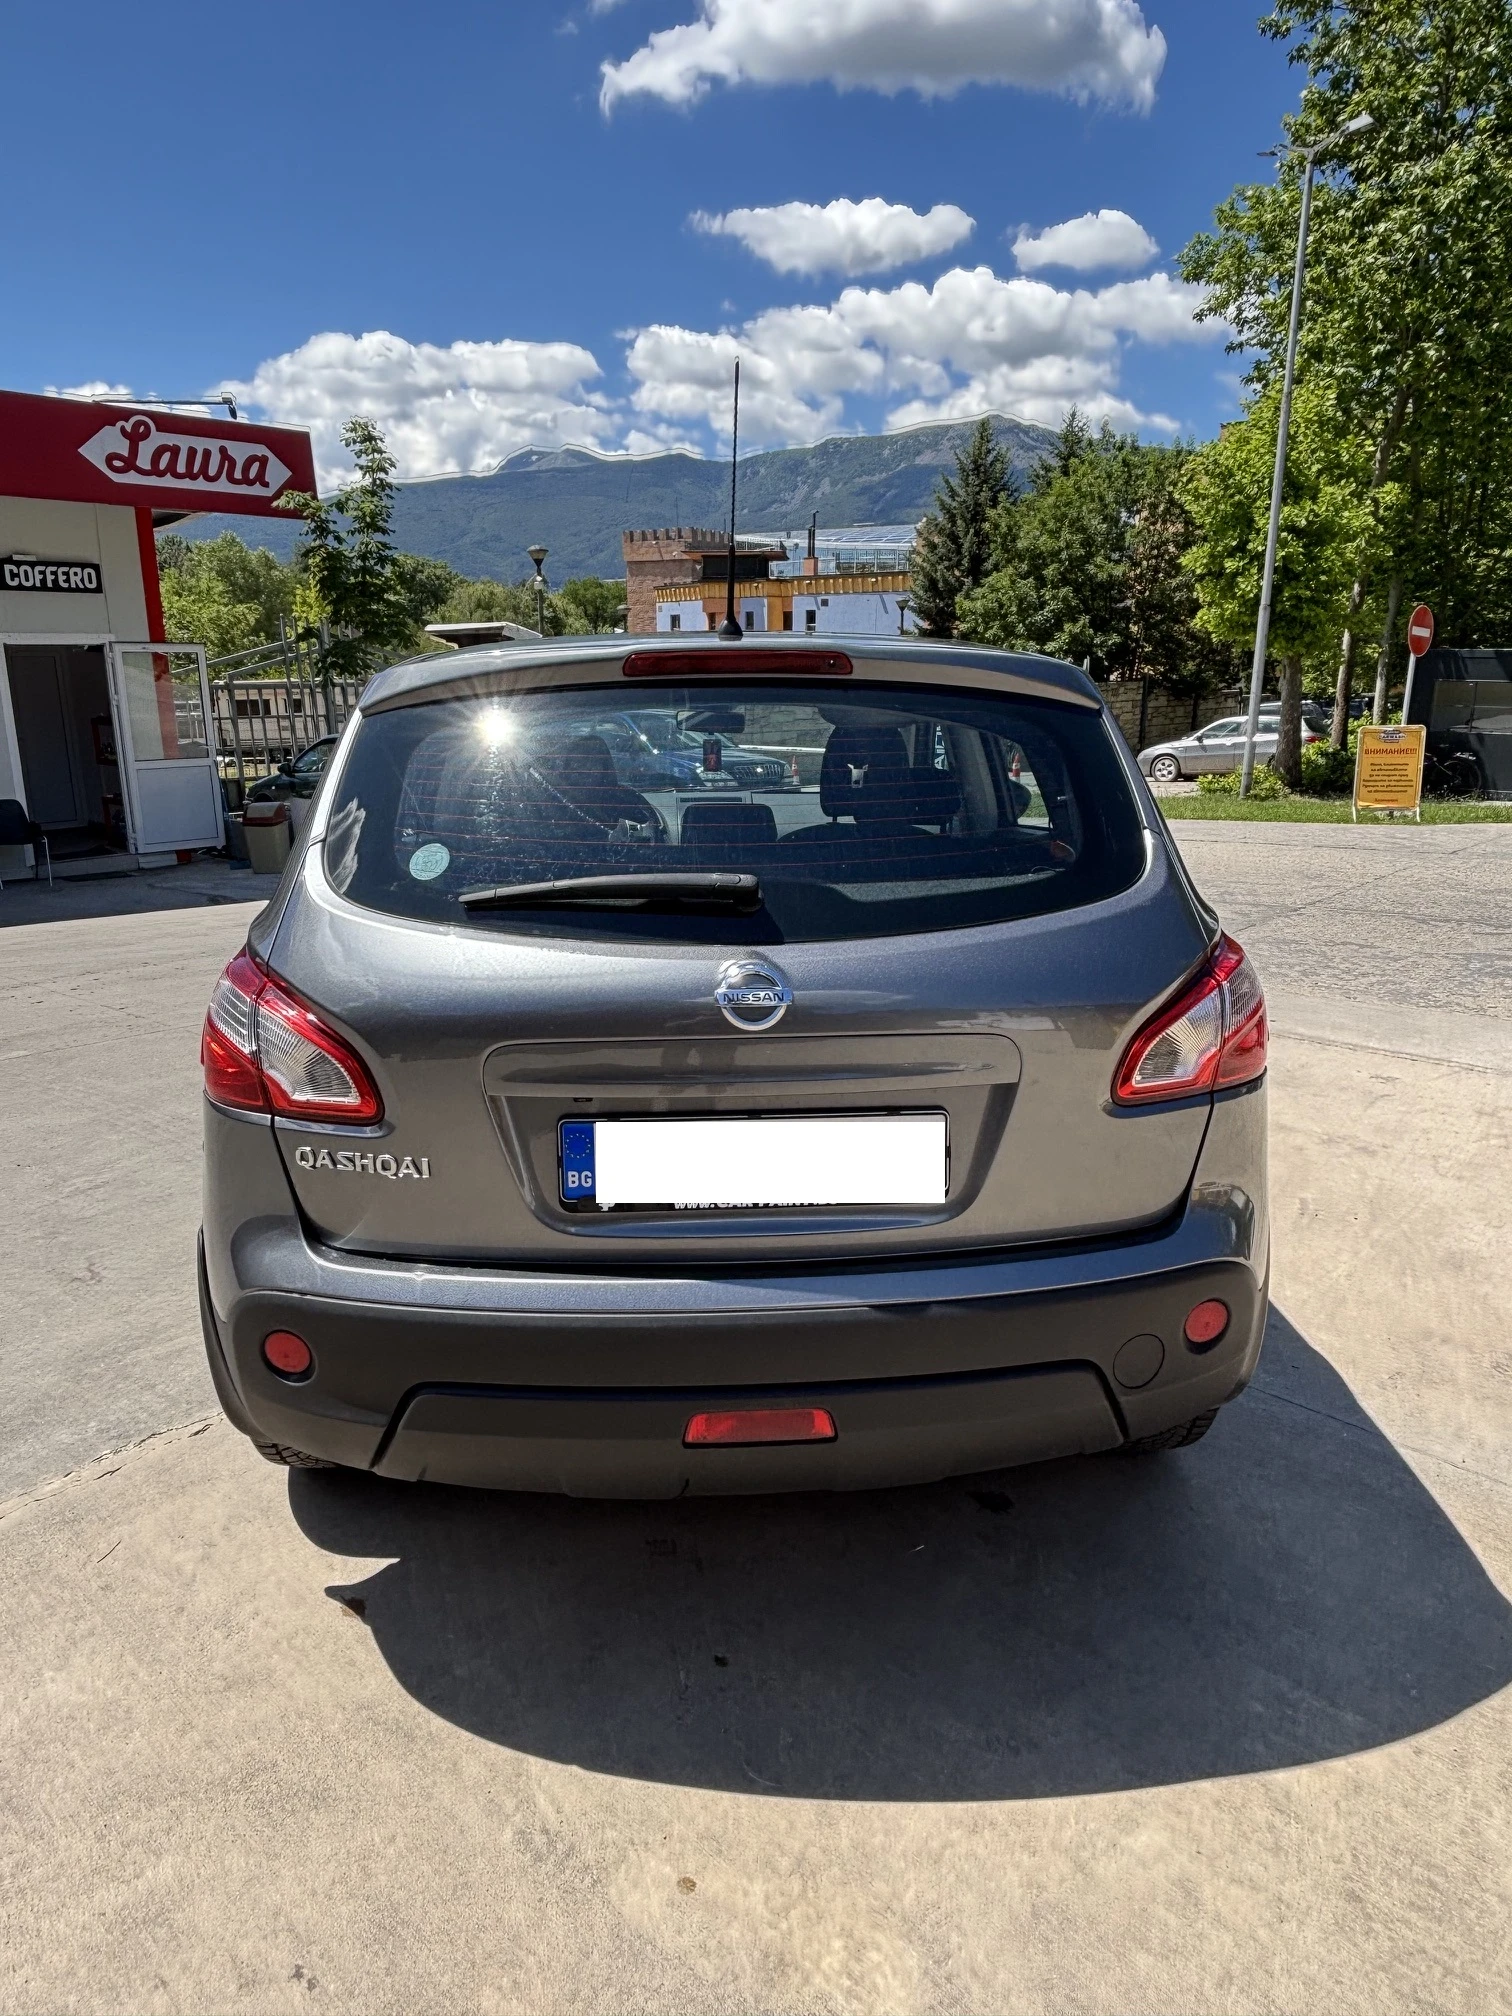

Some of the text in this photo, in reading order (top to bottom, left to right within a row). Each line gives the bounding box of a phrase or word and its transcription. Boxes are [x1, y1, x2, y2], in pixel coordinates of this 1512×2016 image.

[104, 419, 270, 488] Laura
[4, 564, 97, 589] COFFERO
[723, 992, 785, 1003] NISSAN
[295, 1146, 431, 1179] QASHQAI
[567, 1170, 593, 1188] BG
